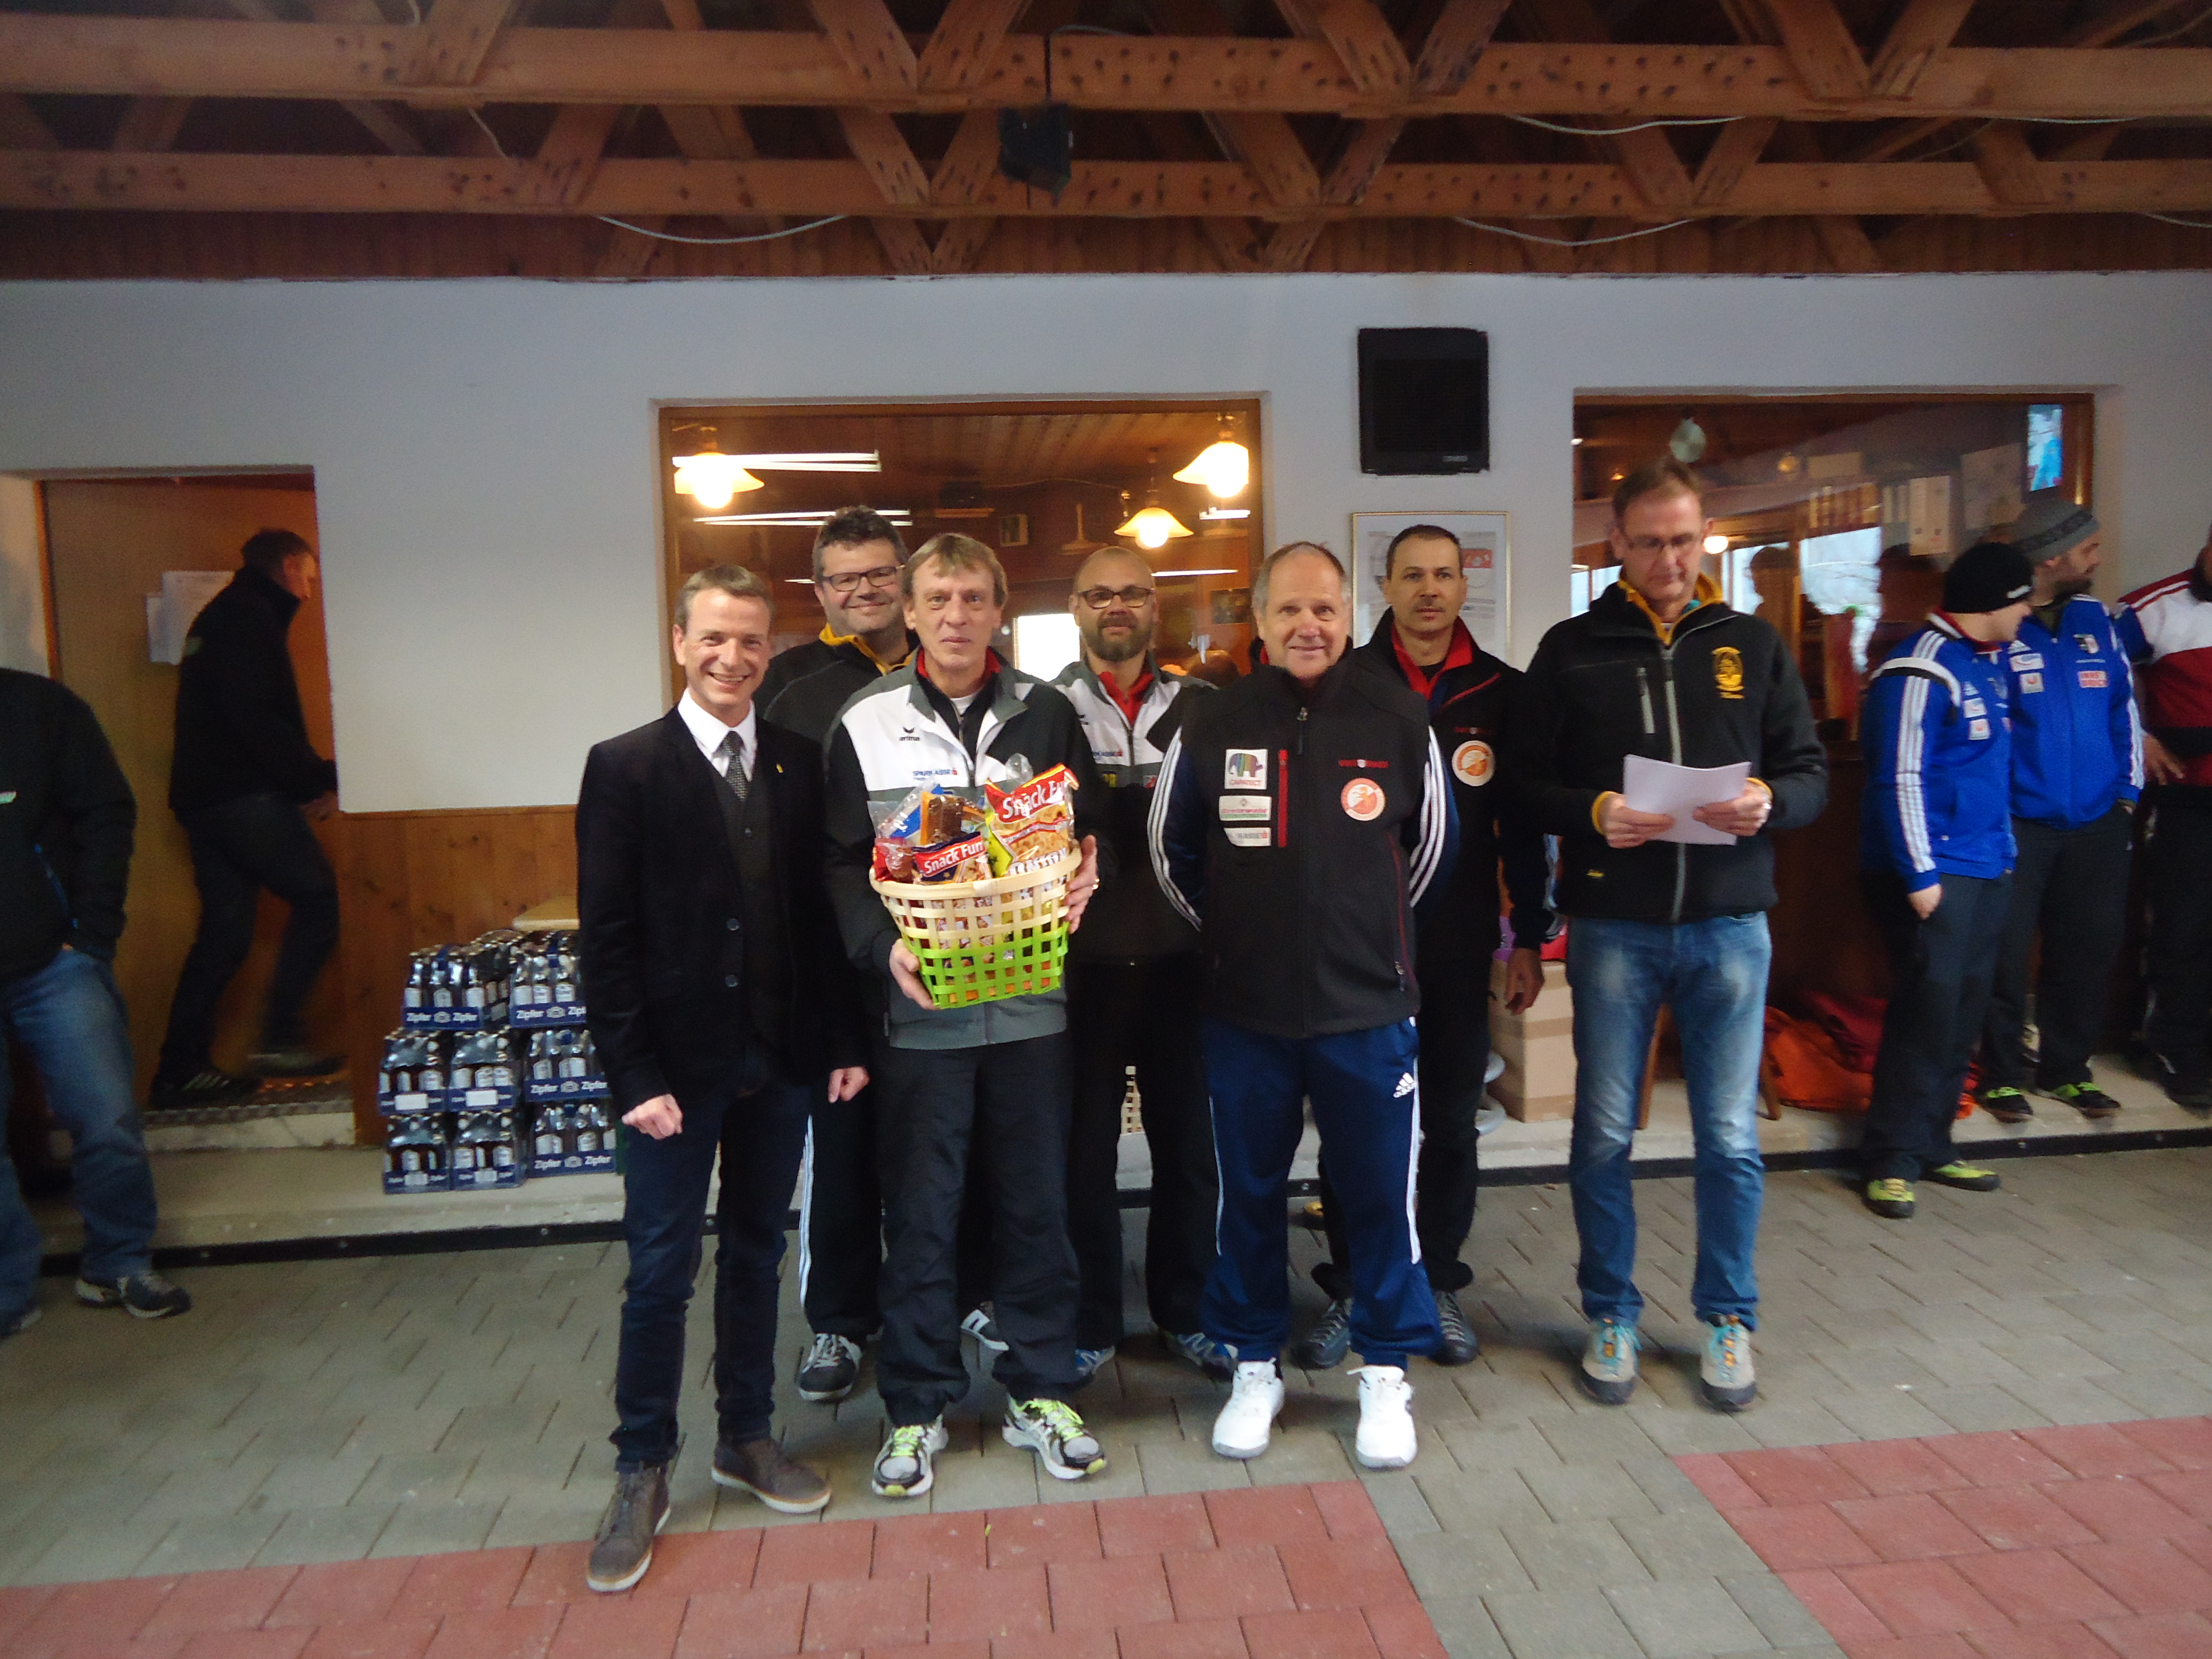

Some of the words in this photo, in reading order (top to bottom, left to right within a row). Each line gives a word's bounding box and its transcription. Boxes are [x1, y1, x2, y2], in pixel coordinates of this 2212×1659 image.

[1002, 784, 1047, 819] Snack
[924, 848, 960, 874] Snack
[960, 841, 983, 857] Fun
[406, 1012, 432, 1023] Zipfer
[453, 1012, 478, 1023] Zipfer
[516, 1009, 544, 1020] Zipfer
[568, 1006, 587, 1017] Zipf
[530, 1084, 559, 1095] Zipfer
[581, 1080, 608, 1092] Zipfer
[534, 1159, 562, 1171] Zipfer
[584, 1156, 612, 1166] Zipfer
